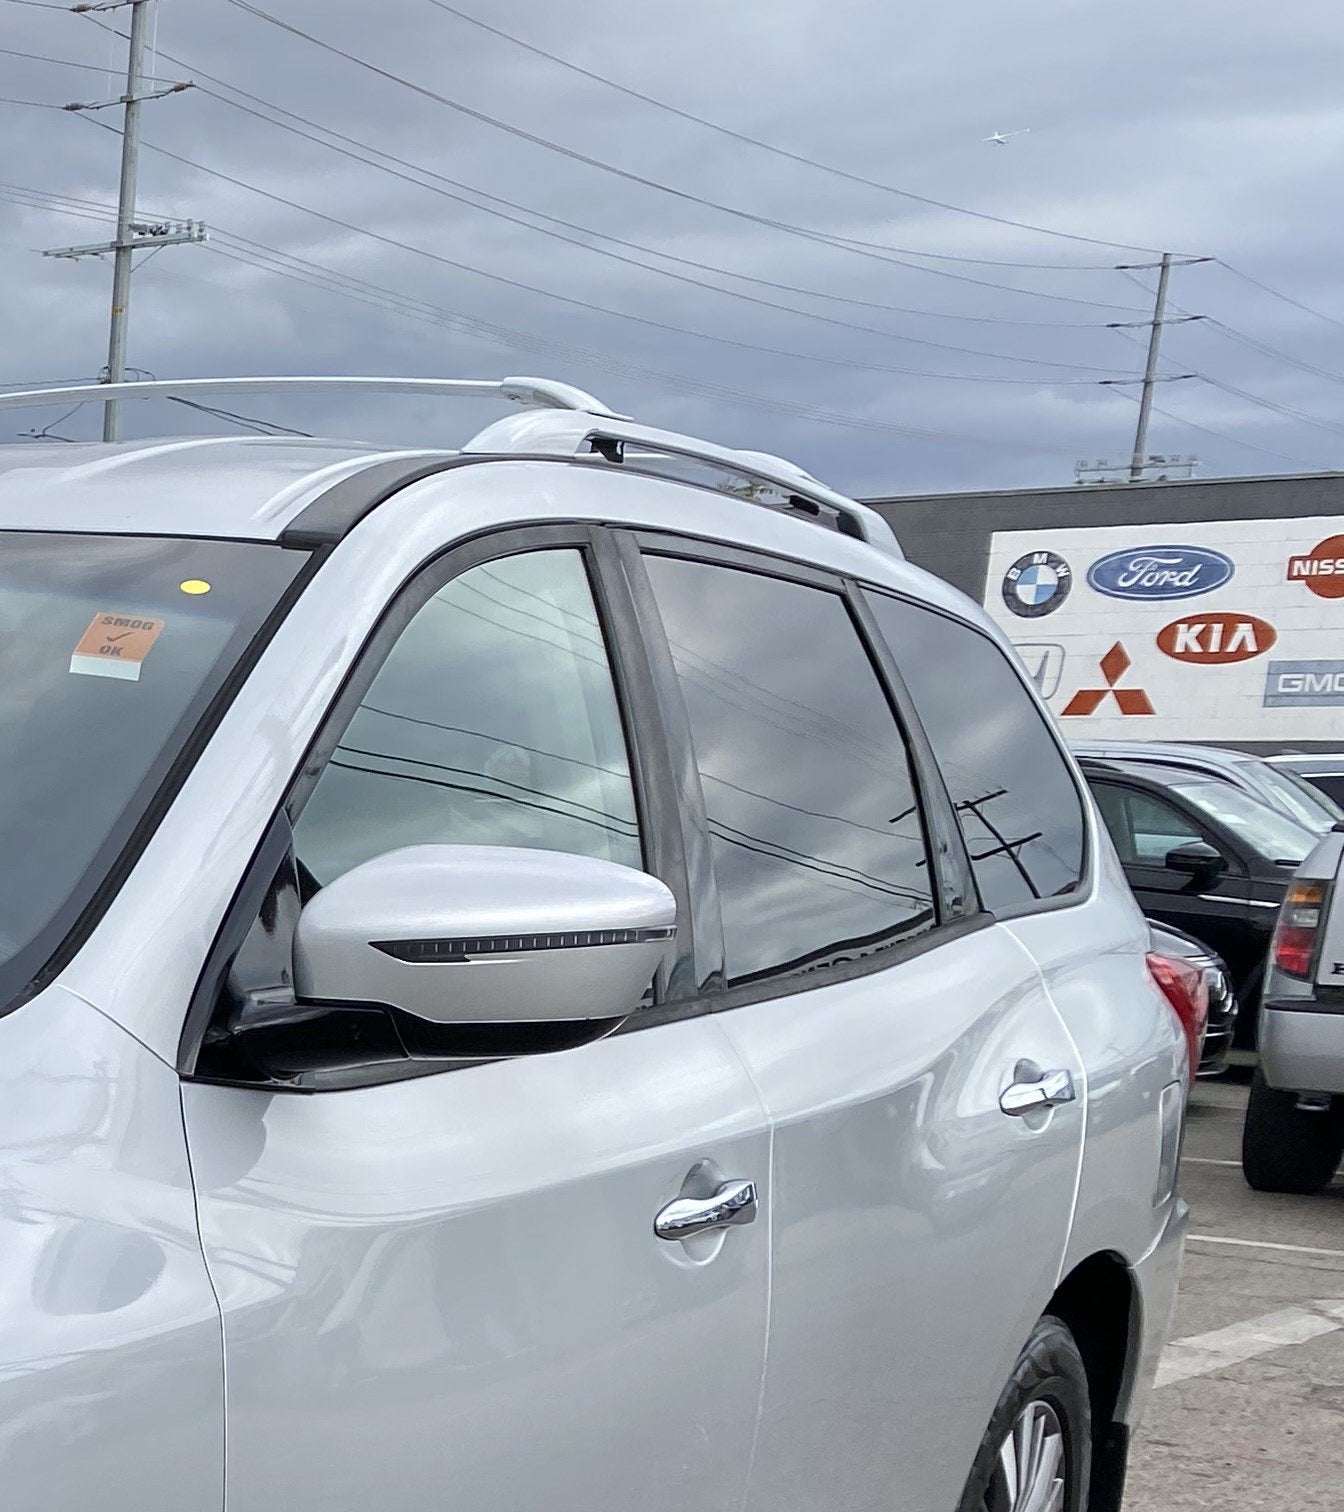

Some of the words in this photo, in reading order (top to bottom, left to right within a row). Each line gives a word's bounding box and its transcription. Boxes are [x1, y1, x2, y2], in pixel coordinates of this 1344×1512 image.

[1007, 552, 1070, 581] BMW
[1117, 556, 1203, 588] Ford
[101, 616, 154, 630] SMOG
[99, 645, 123, 656] OK
[1173, 622, 1258, 654] KIA
